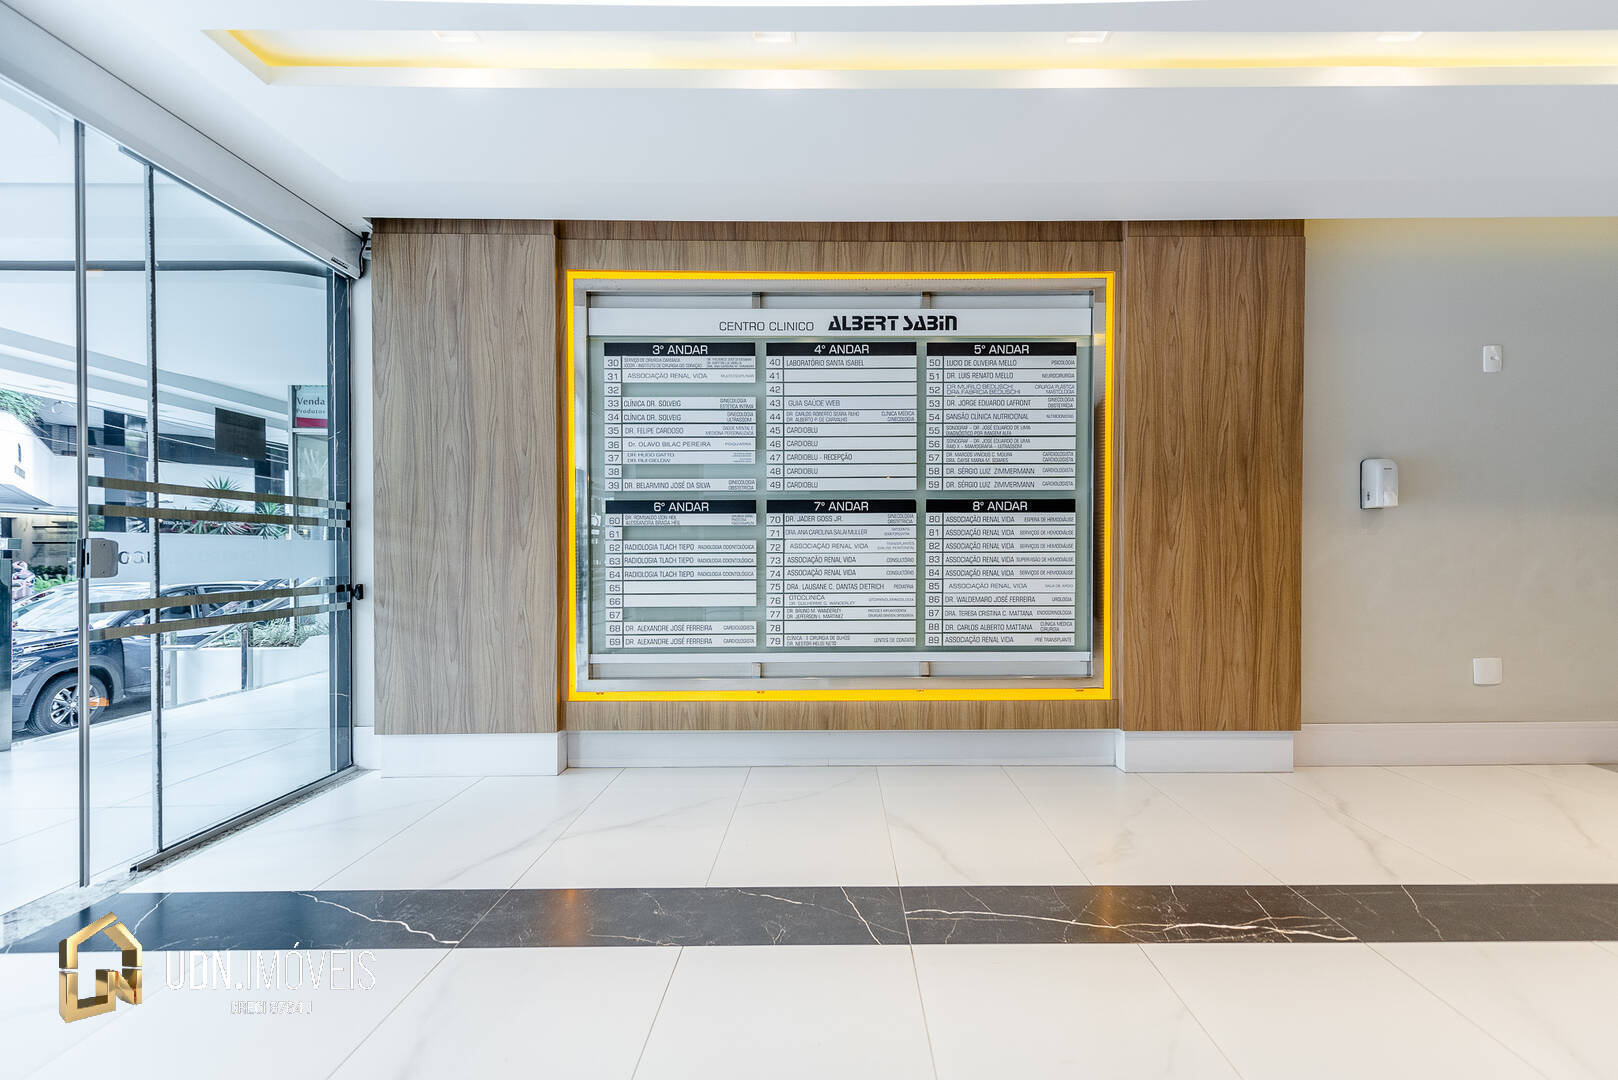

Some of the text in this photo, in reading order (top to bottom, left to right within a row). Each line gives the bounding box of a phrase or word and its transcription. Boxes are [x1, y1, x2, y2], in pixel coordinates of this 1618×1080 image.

[719, 321, 765, 331] CENTRO
[769, 321, 814, 331] CLINICO
[828, 316, 899, 330] ALBERT
[668, 345, 708, 354] ANDAR
[829, 344, 870, 354] ANDAR
[989, 344, 1030, 354] ANDAR
[297, 396, 325, 405] Venda
[668, 502, 709, 512] ANDAR
[828, 502, 869, 511] ANDAR
[988, 502, 1028, 511] ANDAR
